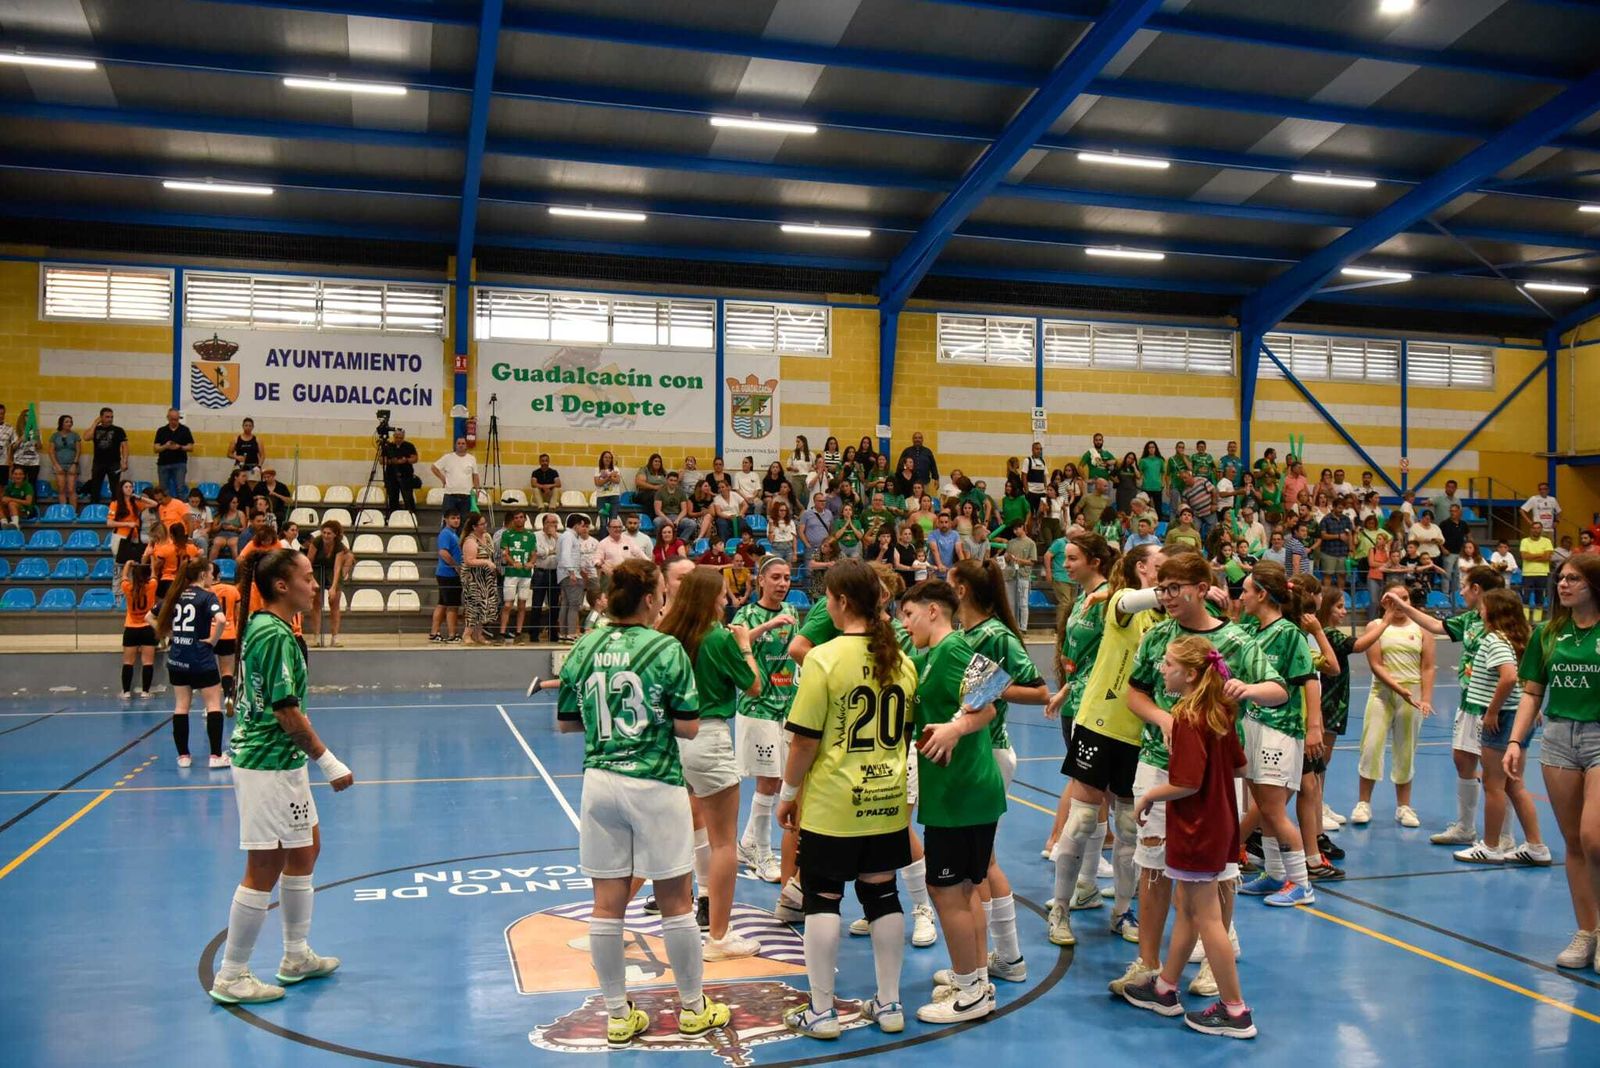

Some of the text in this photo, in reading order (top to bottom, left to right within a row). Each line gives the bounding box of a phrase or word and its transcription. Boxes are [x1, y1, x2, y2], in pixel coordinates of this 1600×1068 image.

[265, 348, 422, 372] AYUNTAMIENTO
[491, 362, 703, 389] Guadalcacín con
[254, 382, 432, 406] DE GUADALCACÍN
[531, 394, 666, 418] el Deporte
[172, 603, 196, 632] 22
[594, 652, 630, 667] NONA
[584, 671, 649, 742] 13
[846, 684, 906, 753] 20
